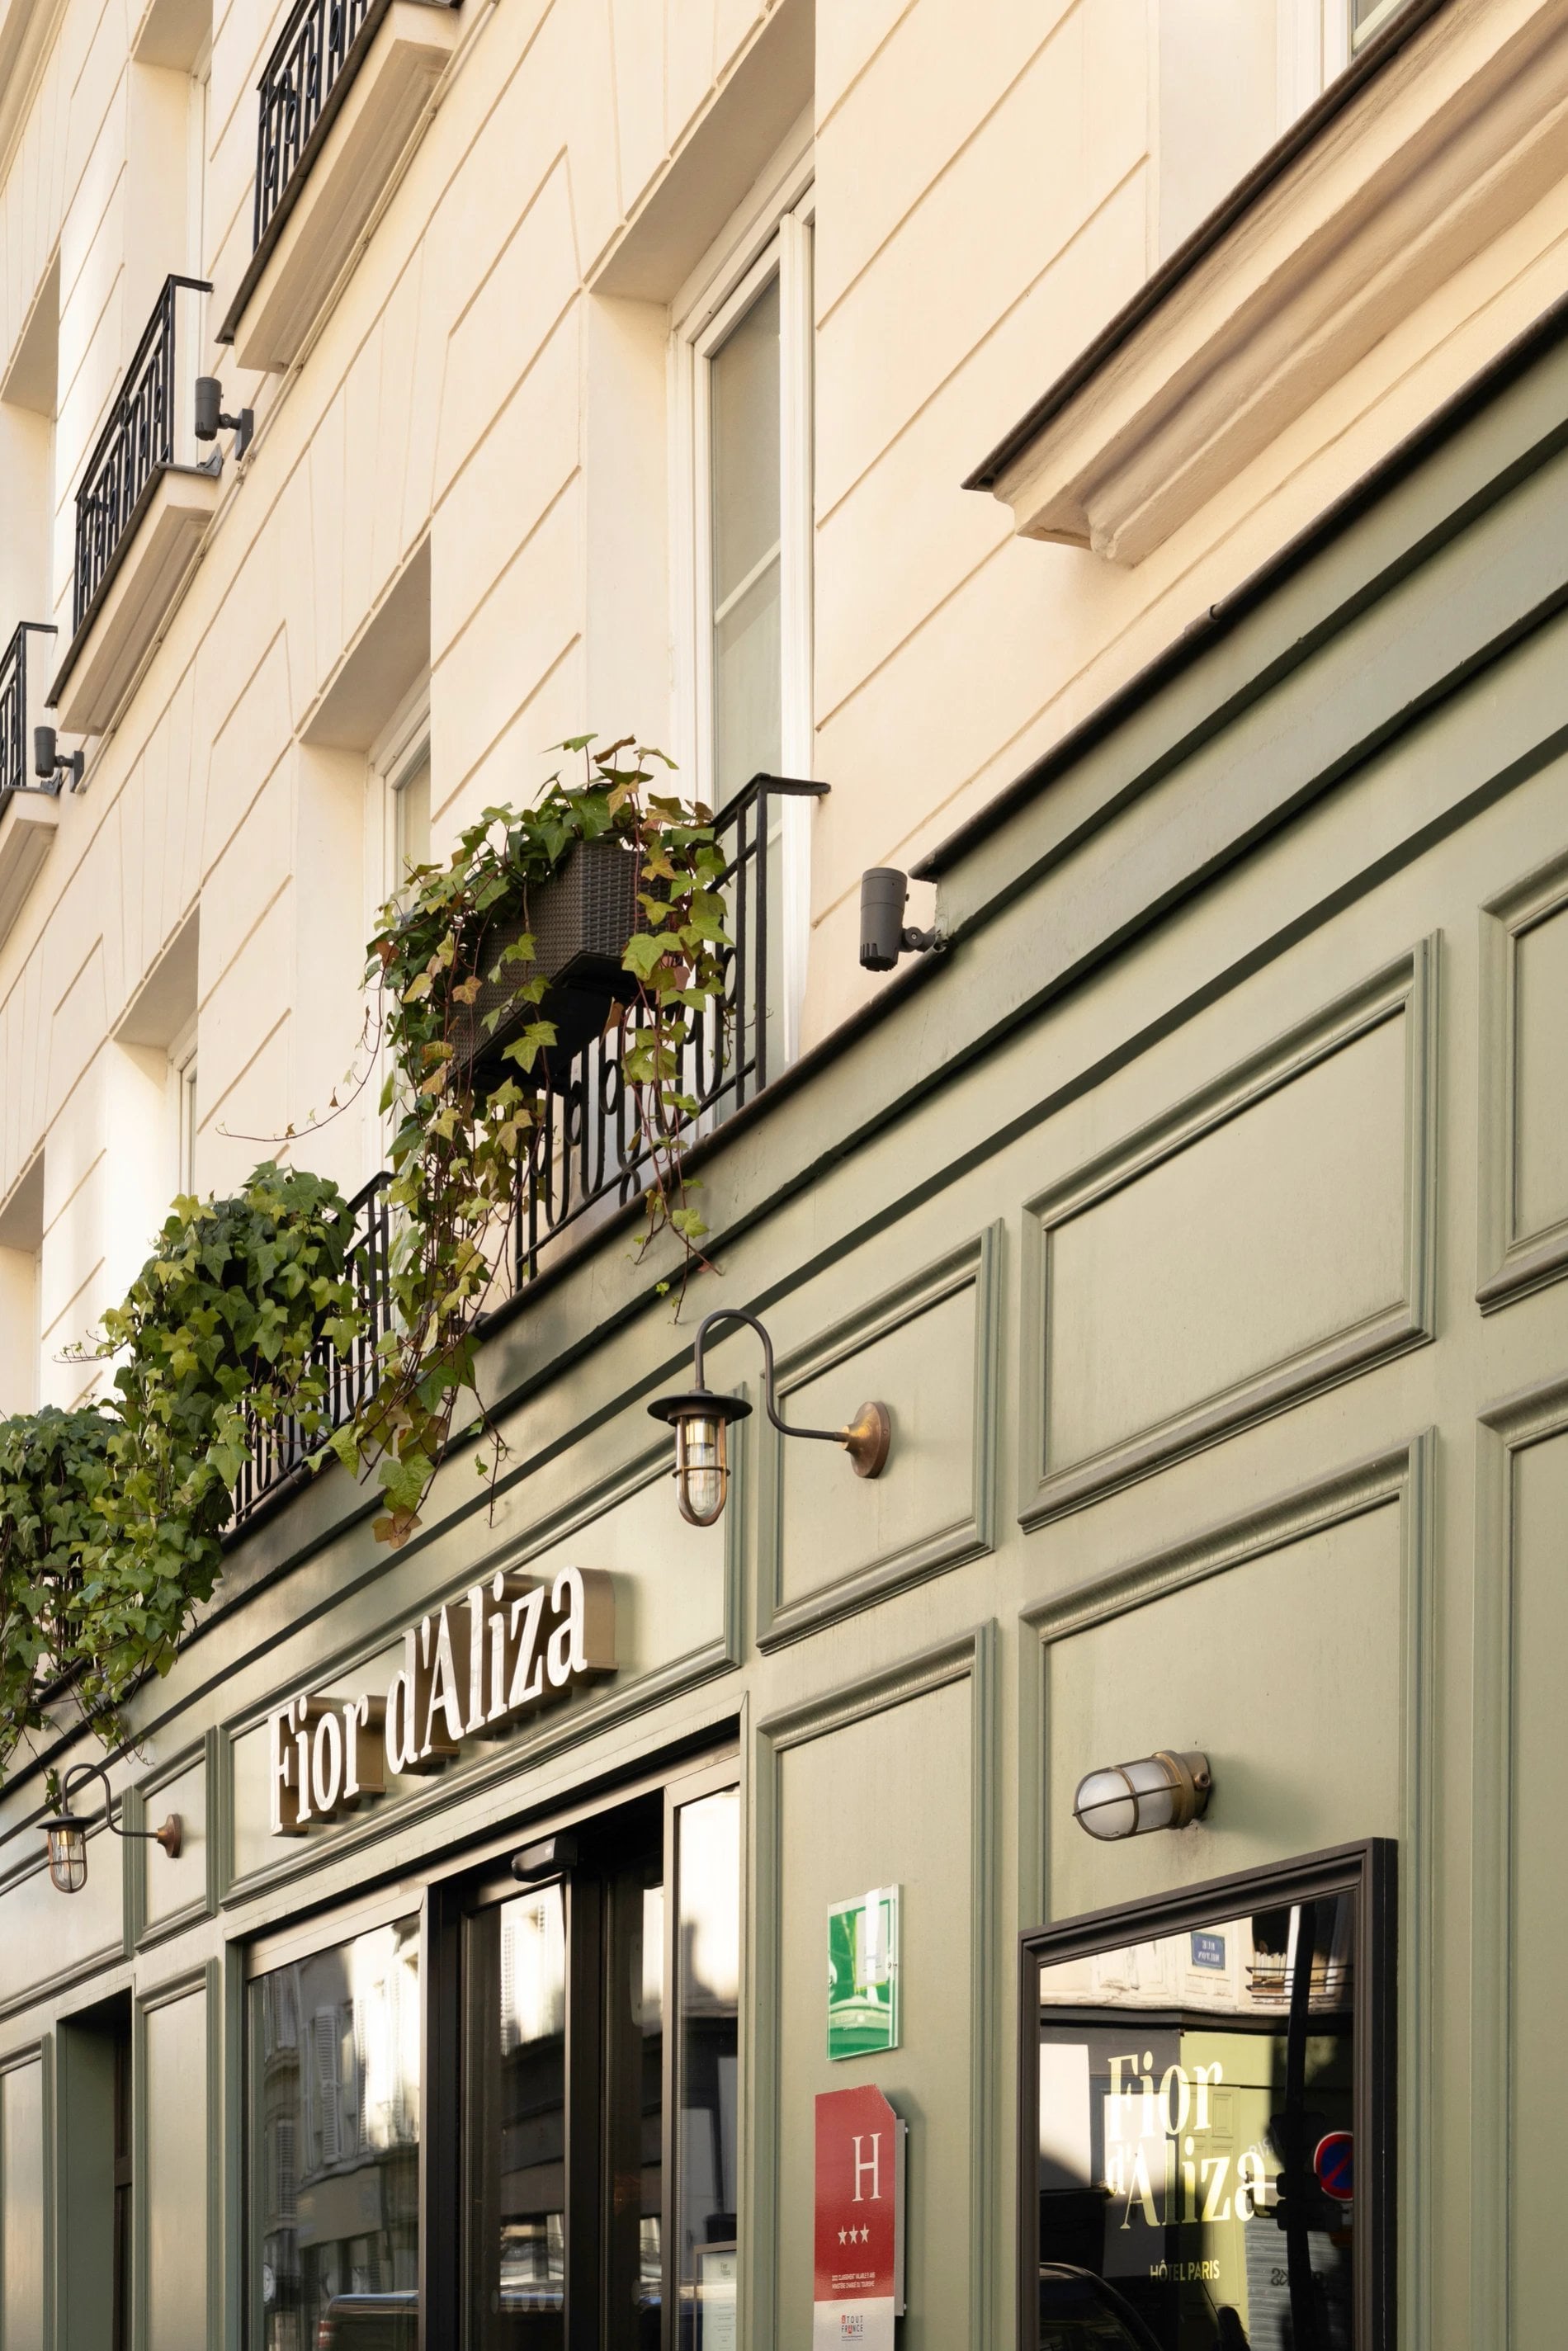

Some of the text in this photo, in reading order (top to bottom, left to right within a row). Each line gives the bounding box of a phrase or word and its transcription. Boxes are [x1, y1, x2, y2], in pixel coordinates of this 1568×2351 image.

[268, 1566, 588, 1836] Fior d'Aliza
[1108, 2051, 1223, 2141] Fior
[852, 2132, 882, 2202] H
[1106, 2136, 1266, 2229] d'Aliza
[1150, 2259, 1220, 2283] HÔTEL PARIS
